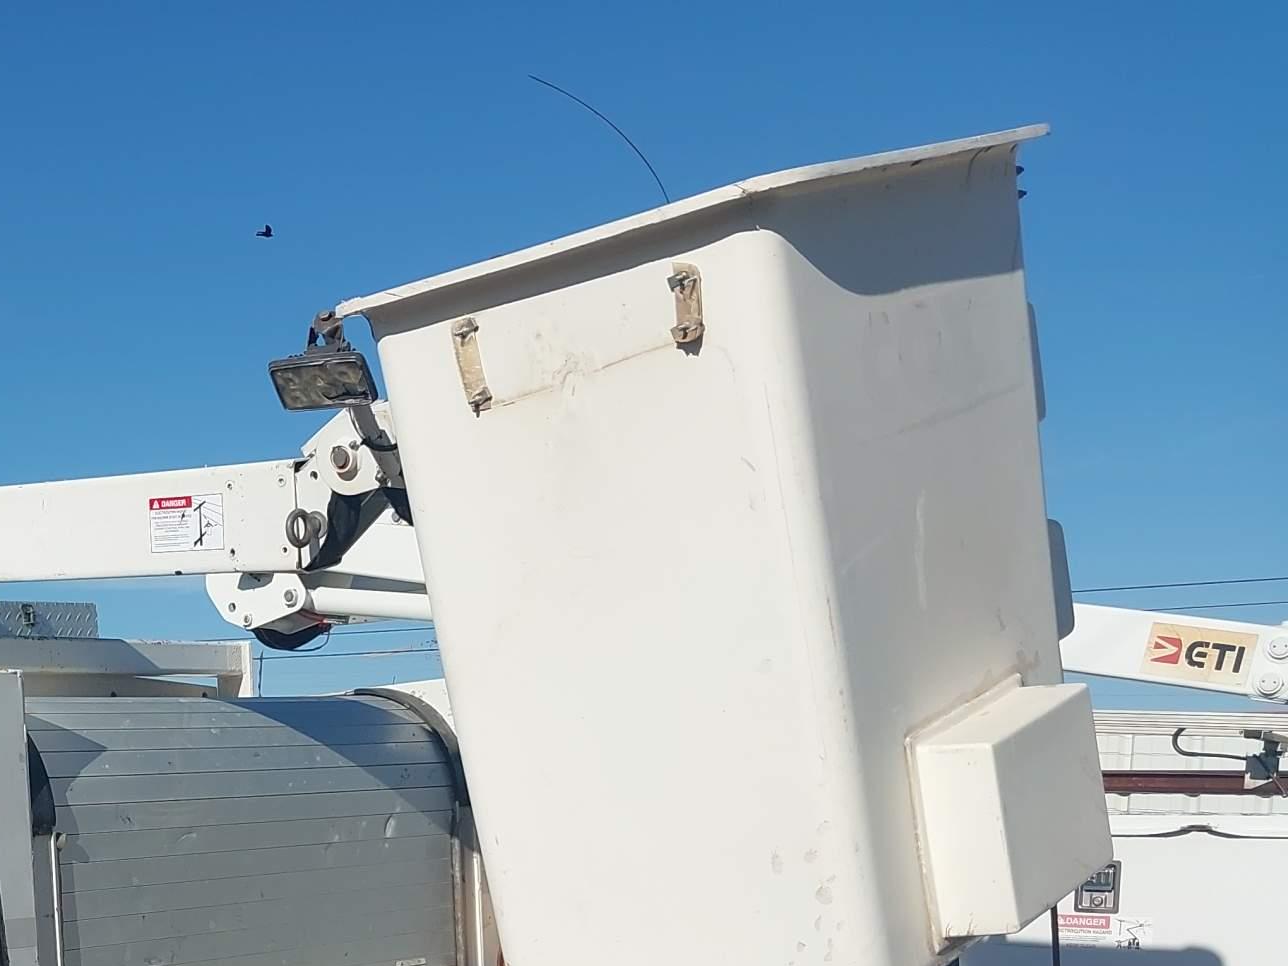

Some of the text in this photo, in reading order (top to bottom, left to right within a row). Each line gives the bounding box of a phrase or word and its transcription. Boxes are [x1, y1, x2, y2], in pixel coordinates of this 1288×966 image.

[161, 499, 187, 508] DANGER
[1185, 640, 1246, 674] ETI
[1066, 917, 1106, 926] DANGER
